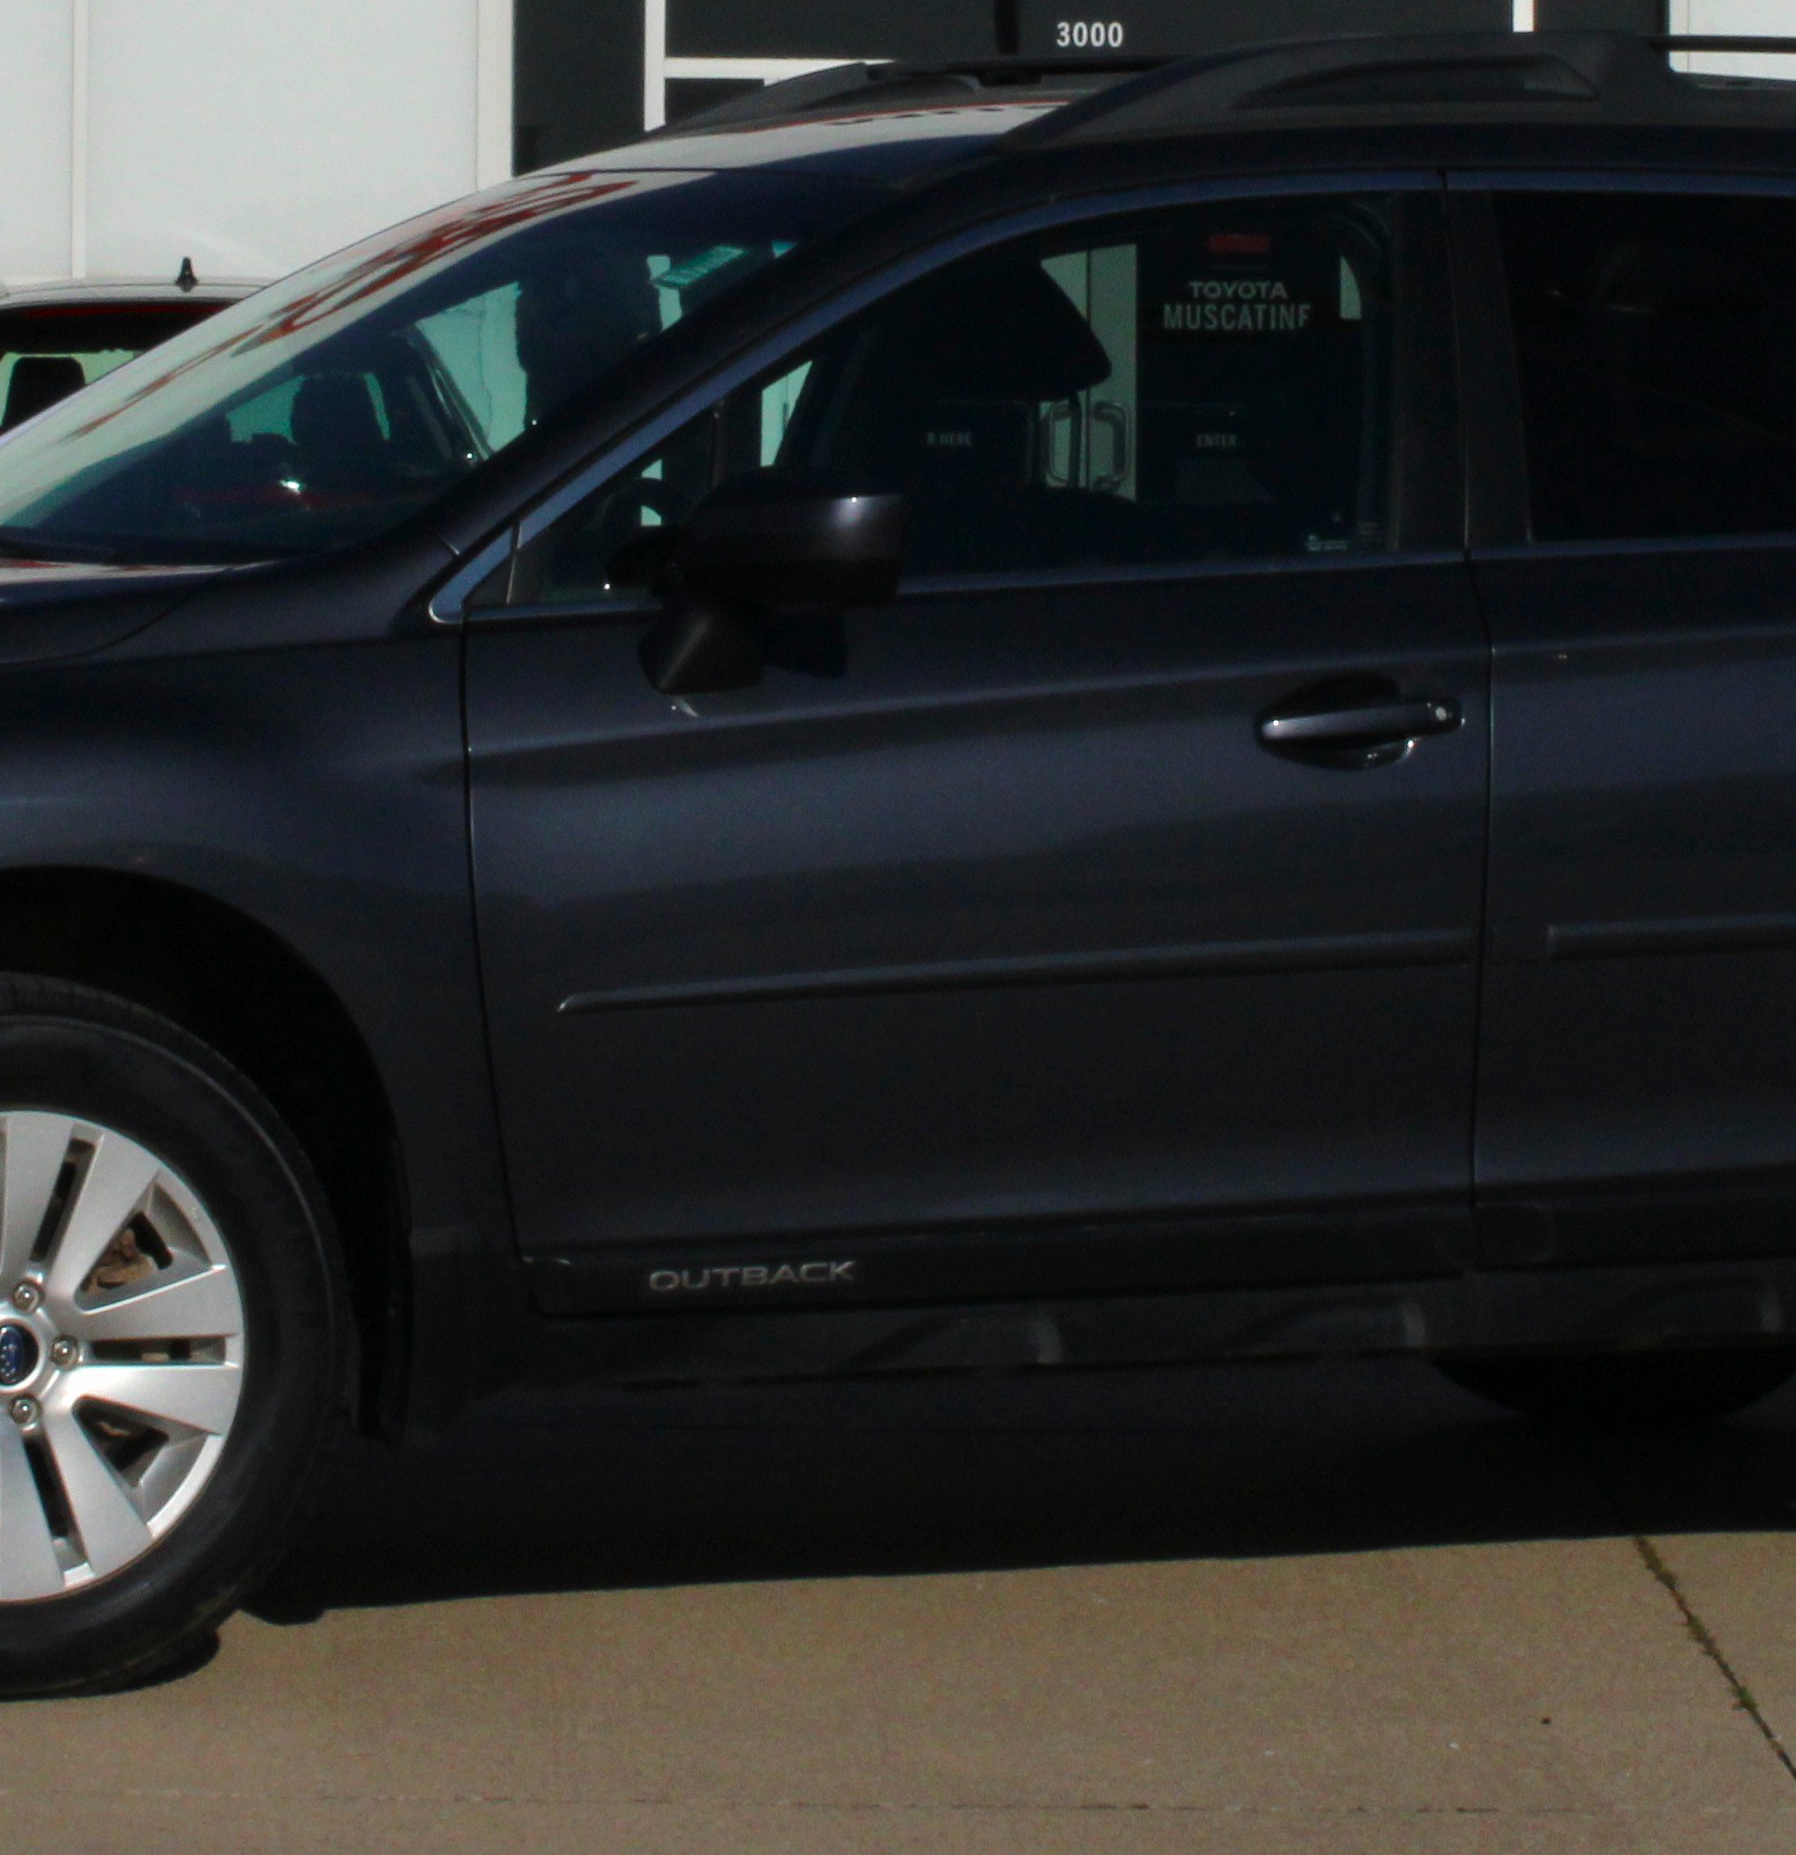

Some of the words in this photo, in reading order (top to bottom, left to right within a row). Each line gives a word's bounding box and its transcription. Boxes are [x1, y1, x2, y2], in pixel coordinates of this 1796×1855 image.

[1055, 21, 1124, 49] 3000
[1188, 280, 1289, 301] TOYOTA
[649, 1261, 856, 1291] OUTBACK
